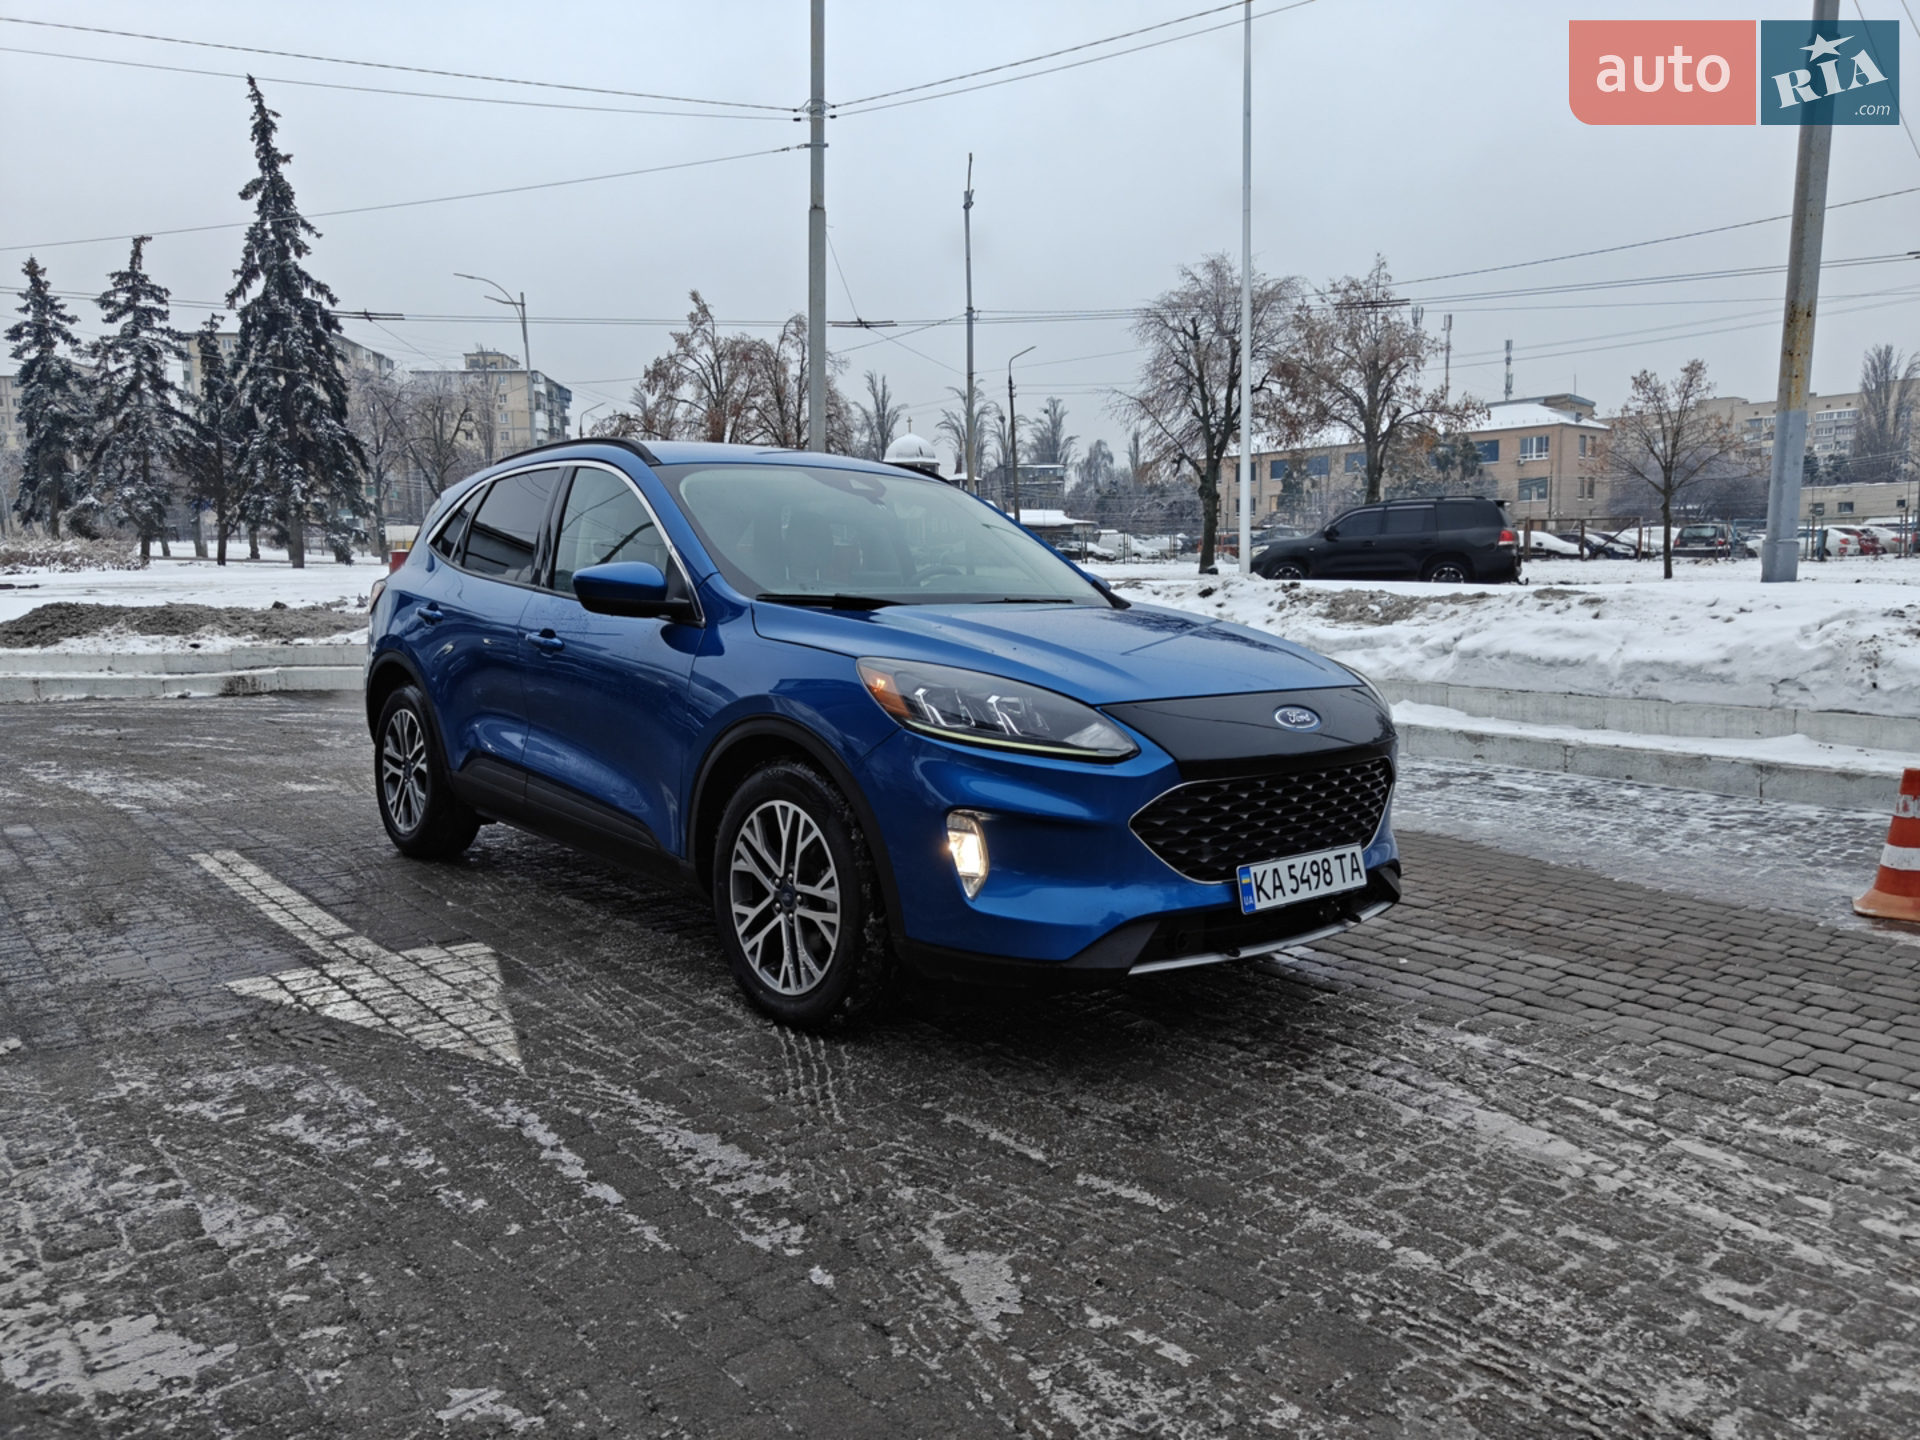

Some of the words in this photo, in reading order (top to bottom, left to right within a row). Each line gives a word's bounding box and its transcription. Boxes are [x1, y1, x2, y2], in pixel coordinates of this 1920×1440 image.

[1286, 711, 1311, 723] Ford
[1253, 867, 1286, 903] KA
[1287, 857, 1333, 895] 5498
[1334, 851, 1363, 884] TA
[1243, 895, 1254, 905] UA
